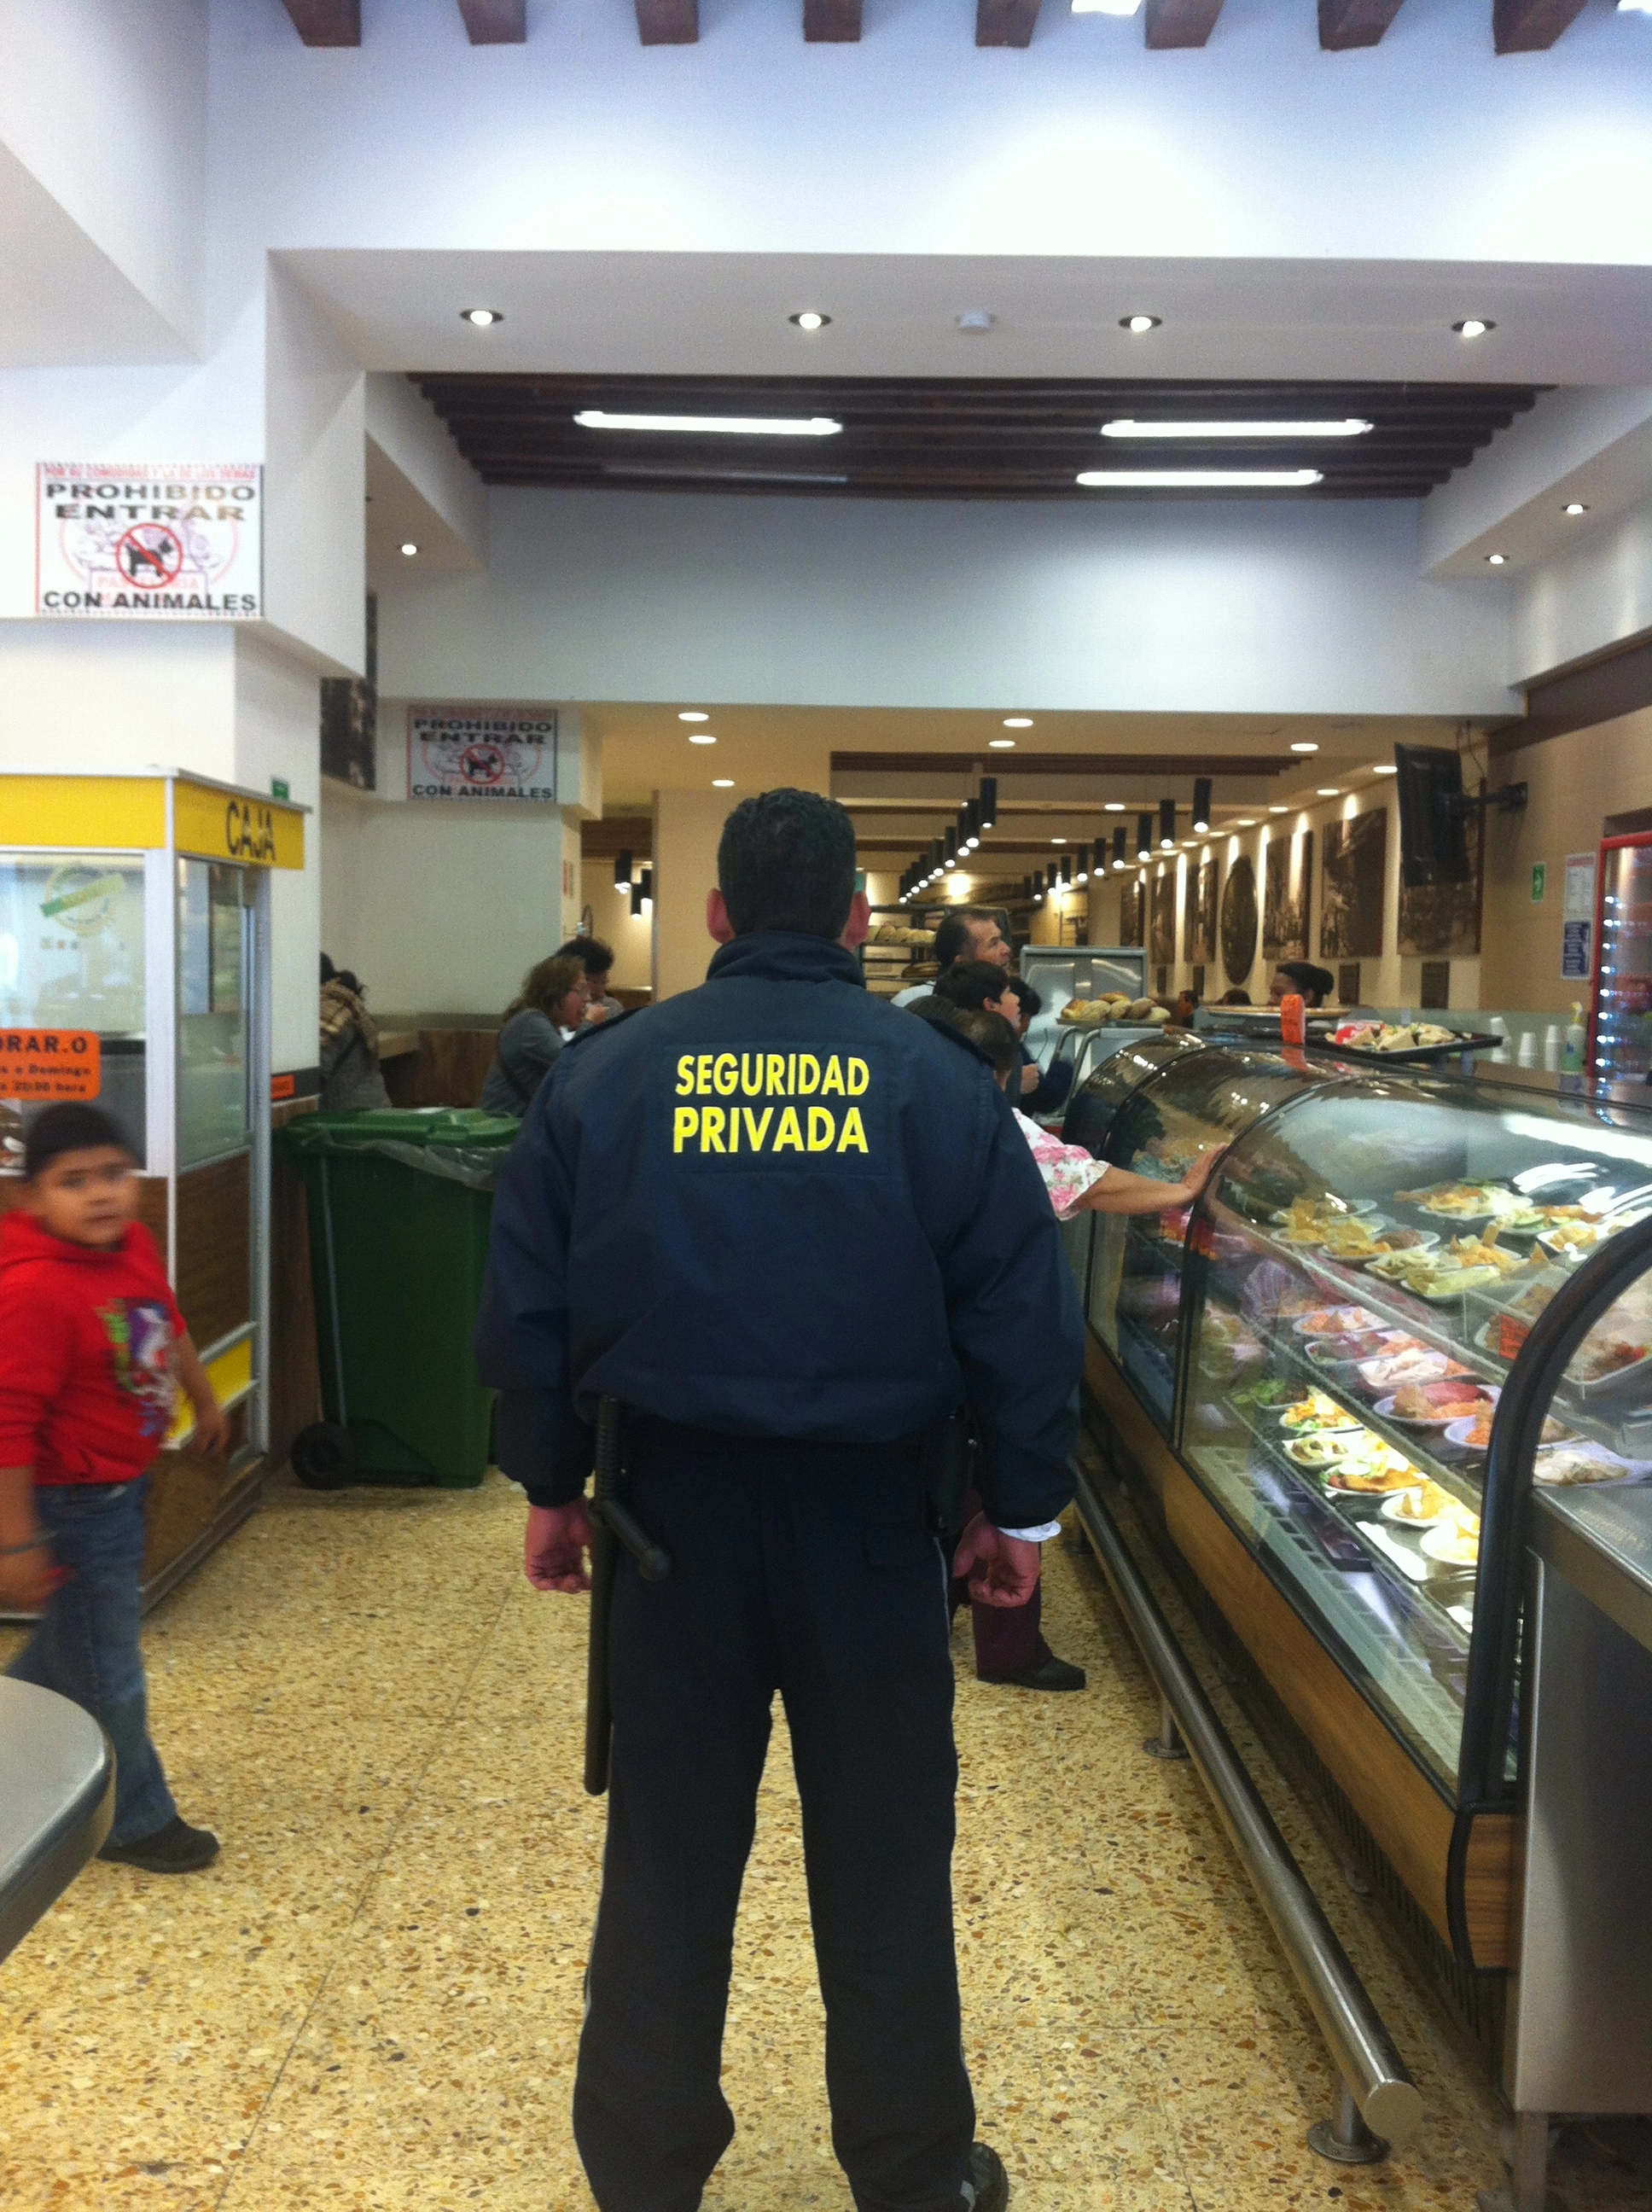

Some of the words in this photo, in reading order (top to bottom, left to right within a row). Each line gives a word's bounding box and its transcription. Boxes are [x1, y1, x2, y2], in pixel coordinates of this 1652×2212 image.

[46, 483, 256, 501] PROHIBIDO
[55, 504, 247, 521] ENTRAR
[44, 591, 102, 608] CON
[113, 592, 257, 610] ANIMALES
[414, 719, 551, 731] PROHIBIDO
[420, 732, 545, 744] ENTRAR
[412, 784, 452, 796] CON
[458, 786, 552, 798] ANIMALES
[225, 800, 277, 861] CAJA
[675, 1052, 870, 1096] SEGURIDAD
[673, 1106, 870, 1153] PRIVADA
